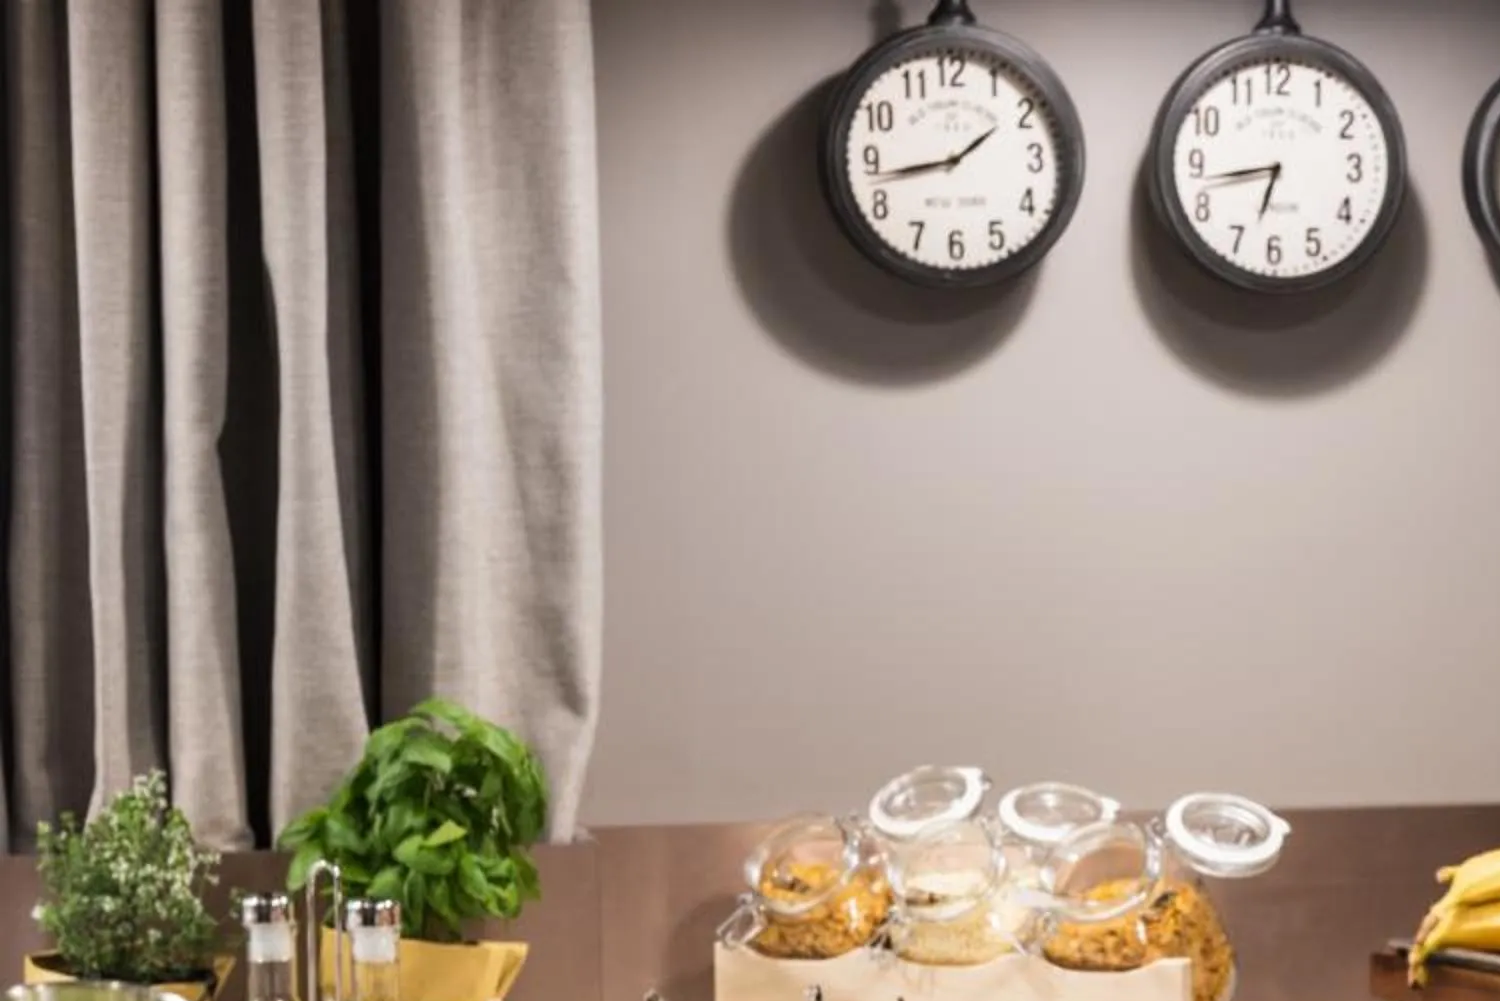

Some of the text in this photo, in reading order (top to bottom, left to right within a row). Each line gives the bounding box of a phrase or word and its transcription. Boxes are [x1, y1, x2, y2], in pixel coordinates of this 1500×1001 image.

[902, 69, 927, 100] 11
[937, 56, 966, 88] 12
[989, 68, 999, 97] 1
[1264, 64, 1292, 97] 12
[1231, 79, 1254, 105] 11
[1313, 80, 1323, 107] 1
[864, 101, 894, 133] 10
[1016, 97, 1034, 130] 2
[1193, 107, 1220, 137] 10
[1339, 110, 1355, 139] 2
[862, 145, 880, 175] 9
[1026, 143, 1044, 174] 3
[1188, 150, 1205, 179] 9
[1347, 154, 1363, 183] 3
[871, 190, 888, 221] 8
[1019, 188, 1035, 217] 4
[1194, 193, 1211, 223] 8
[1337, 197, 1352, 224] 4
[909, 221, 926, 251] 7
[948, 230, 966, 261] 6
[988, 221, 1006, 251] 5
[1229, 225, 1245, 255] 7
[1267, 236, 1282, 266] 6
[1305, 228, 1322, 257] 5
